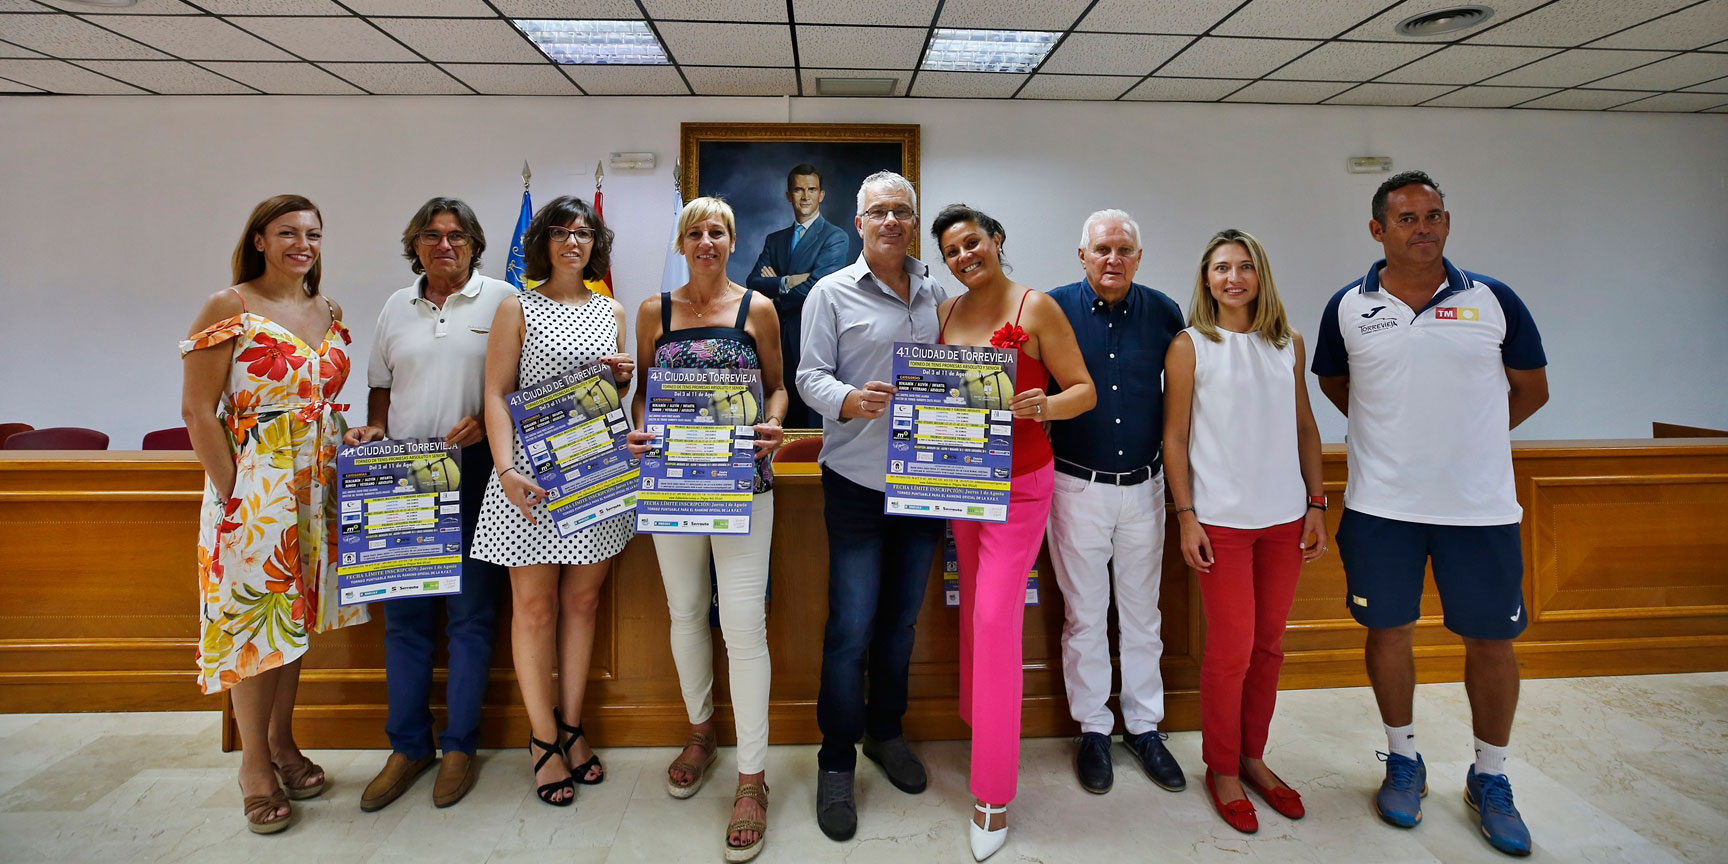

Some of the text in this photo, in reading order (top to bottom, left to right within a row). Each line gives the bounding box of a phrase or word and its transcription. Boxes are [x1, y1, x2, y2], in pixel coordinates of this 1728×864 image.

[1358, 320, 1398, 333] TORREVIEJA
[896, 347, 1014, 363] 41 CIUDAD DE TORREVIEJA
[510, 362, 607, 407] 41 CIUDAD DE TORREVIEJA
[650, 371, 757, 383] 41 CIUDAD DE TORREVIEJA
[357, 446, 391, 456] CIUDAD
[394, 444, 404, 453] DE
[406, 441, 458, 453] TORREVIEA
